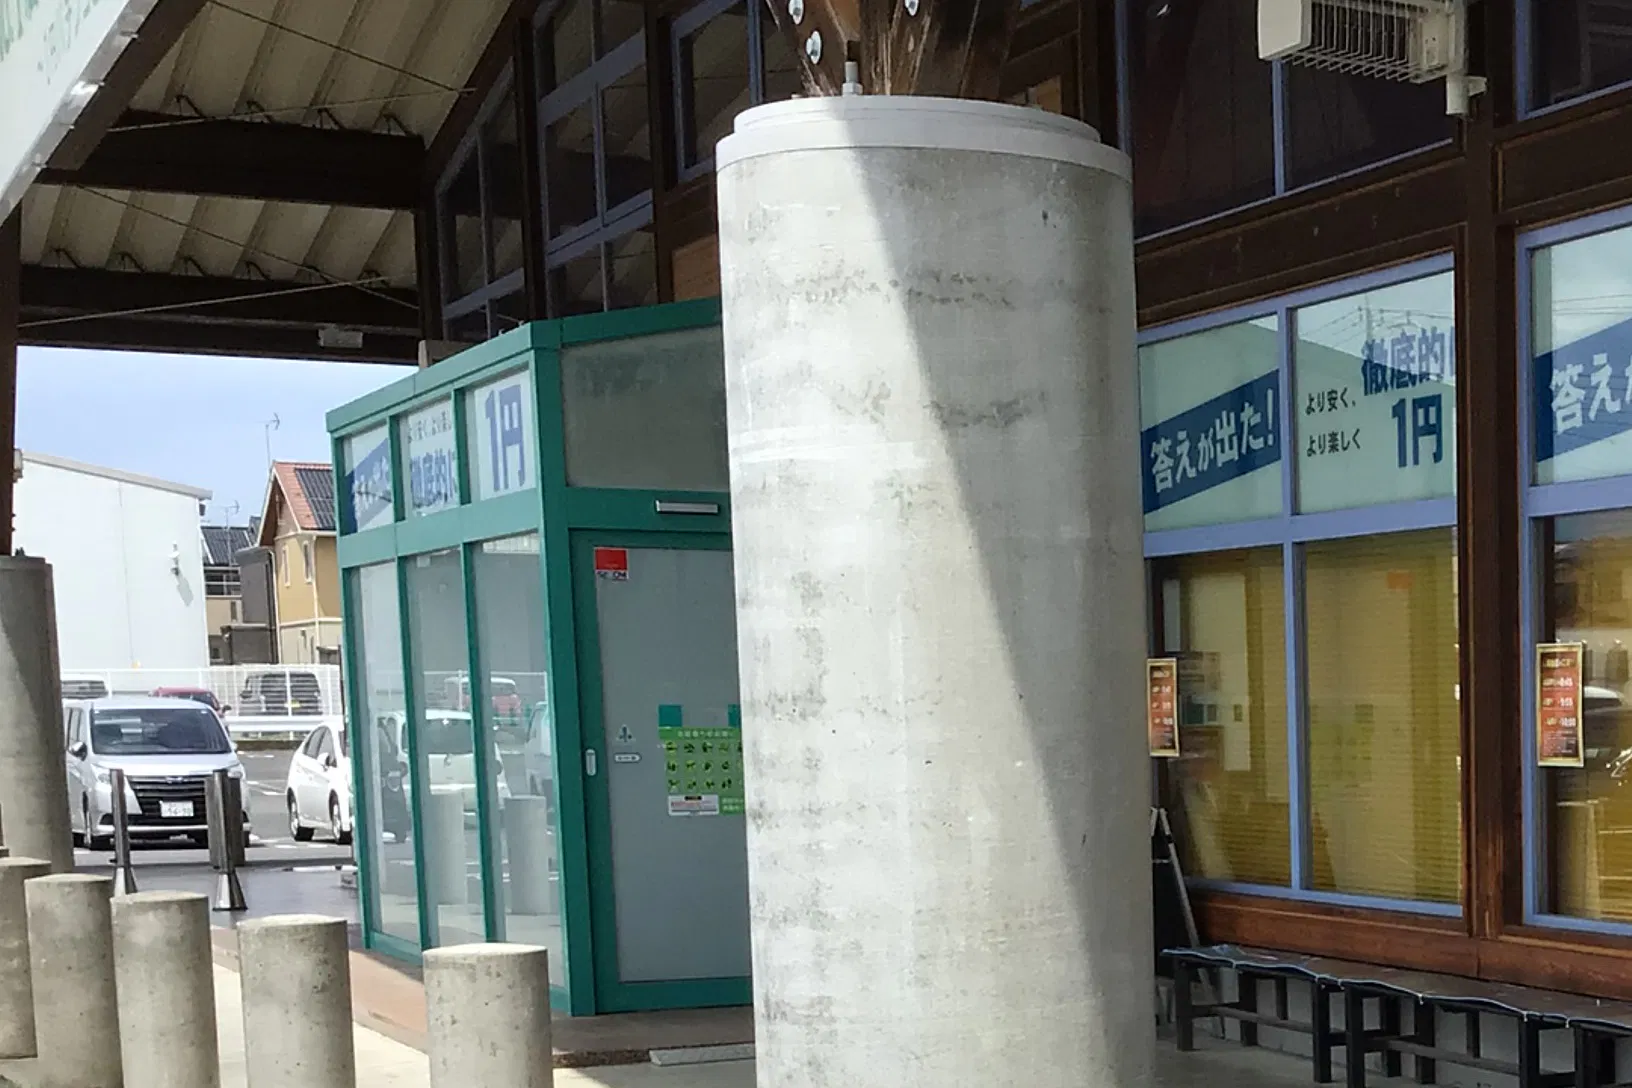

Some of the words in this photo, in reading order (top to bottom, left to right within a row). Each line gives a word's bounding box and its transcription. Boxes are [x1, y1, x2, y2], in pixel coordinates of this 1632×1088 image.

[484, 383, 526, 493] 1円
[1150, 388, 1274, 494] 答えが出た!
[1306, 428, 1361, 458] より楽しく
[1391, 393, 1444, 468] 1円
